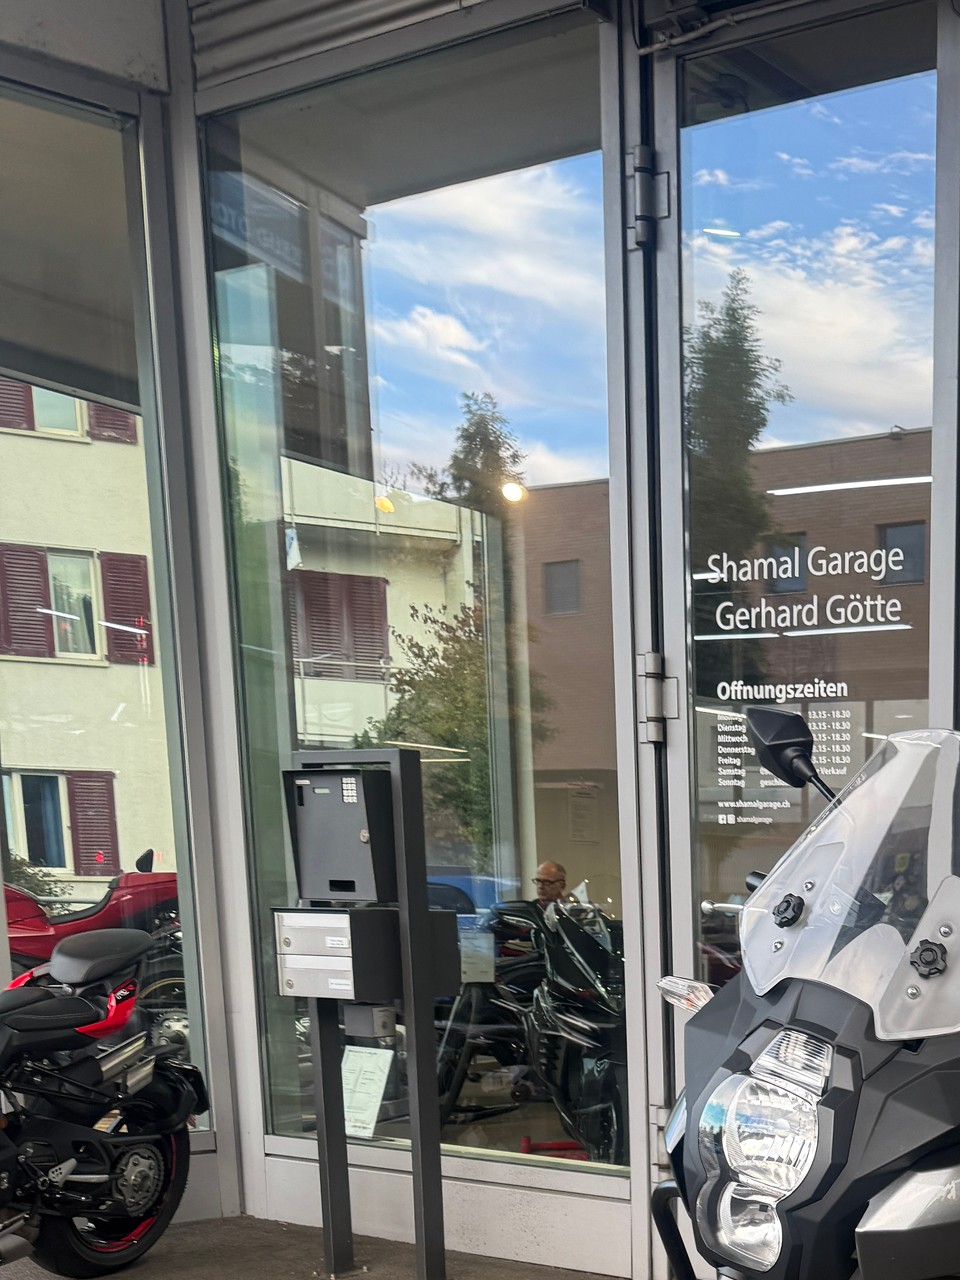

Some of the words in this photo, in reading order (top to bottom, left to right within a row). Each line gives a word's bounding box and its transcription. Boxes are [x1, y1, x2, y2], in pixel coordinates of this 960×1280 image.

[707, 546, 800, 583] Shamal
[807, 546, 904, 581] Garage
[715, 594, 818, 630] Gerhard
[826, 593, 902, 625] Götte
[831, 710, 851, 719] 18.30
[717, 724, 747, 733] Dienstag
[831, 722, 851, 730] 18.30
[717, 734, 748, 743] Mittwoch
[831, 733, 851, 741] 18.30
[717, 746, 756, 756] Donnerstag
[831, 744, 851, 752] 18.30
[717, 756, 741, 766] Freitag
[831, 756, 851, 764] 18.30
[717, 767, 746, 777] Samstag
[820, 767, 847, 775] Verkauf
[717, 778, 746, 787] Sonntag
[717, 799, 791, 810] www.shamalgarage.ch
